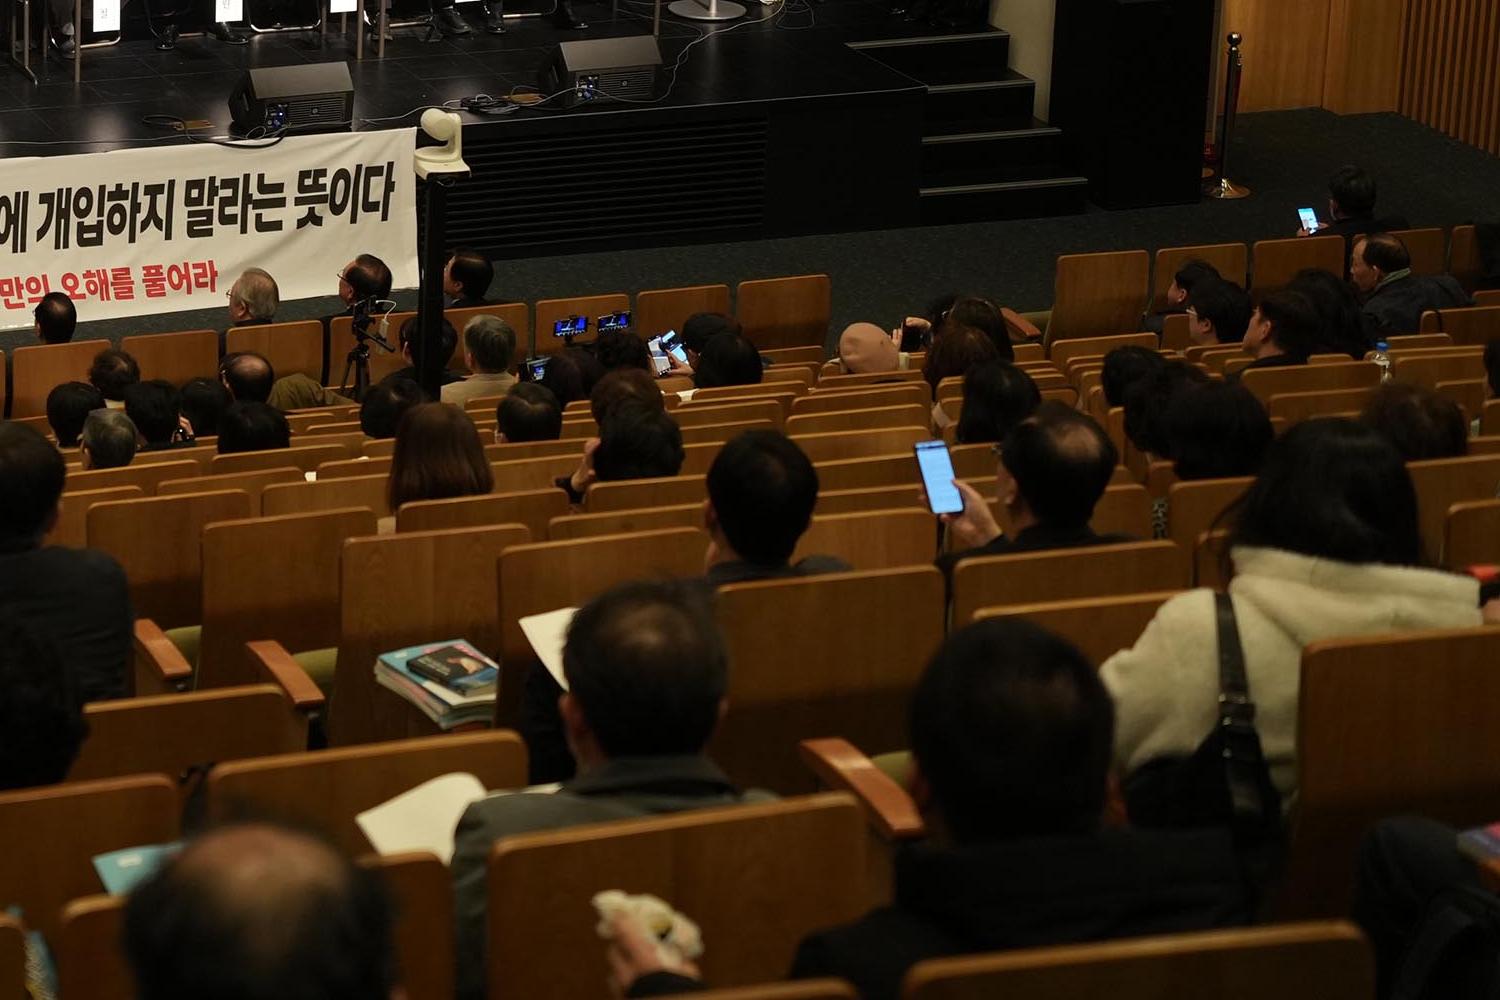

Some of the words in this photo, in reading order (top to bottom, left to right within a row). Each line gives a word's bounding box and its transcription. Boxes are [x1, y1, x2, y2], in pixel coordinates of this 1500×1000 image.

[36, 178, 176, 251] 개입하지
[184, 172, 287, 240] 말라는
[295, 160, 396, 230] 뜻이다
[60, 266, 136, 302] 오해를
[141, 260, 219, 298] 풀어라
